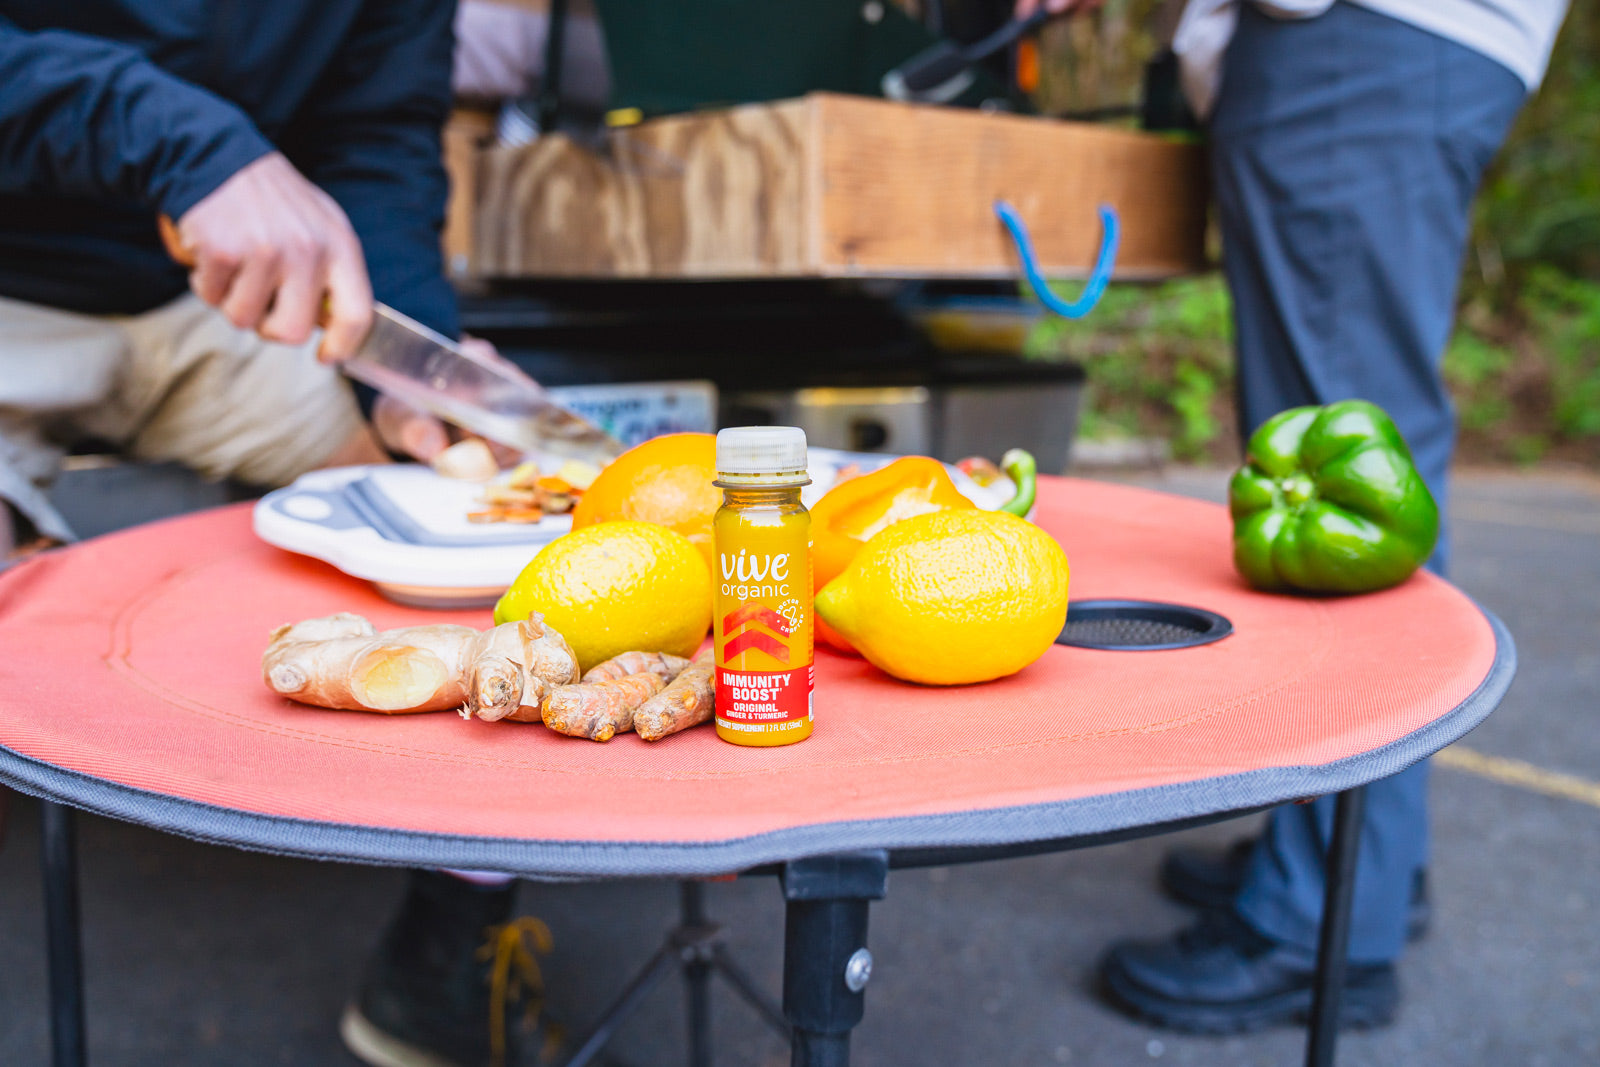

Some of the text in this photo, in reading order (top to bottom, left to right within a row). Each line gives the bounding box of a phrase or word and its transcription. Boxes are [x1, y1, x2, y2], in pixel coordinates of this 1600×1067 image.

[721, 548, 789, 582] vive
[721, 583, 790, 601] organic
[775, 598, 799, 614] DOCTOR
[723, 672, 791, 688] IMMUNITY
[726, 710, 788, 720] GINGER & TURMERIC
[733, 702, 778, 712] ORIGINAL
[732, 723, 765, 732] SUPPLEMENT
[773, 724, 779, 732] FL
[780, 723, 787, 731] OZ
